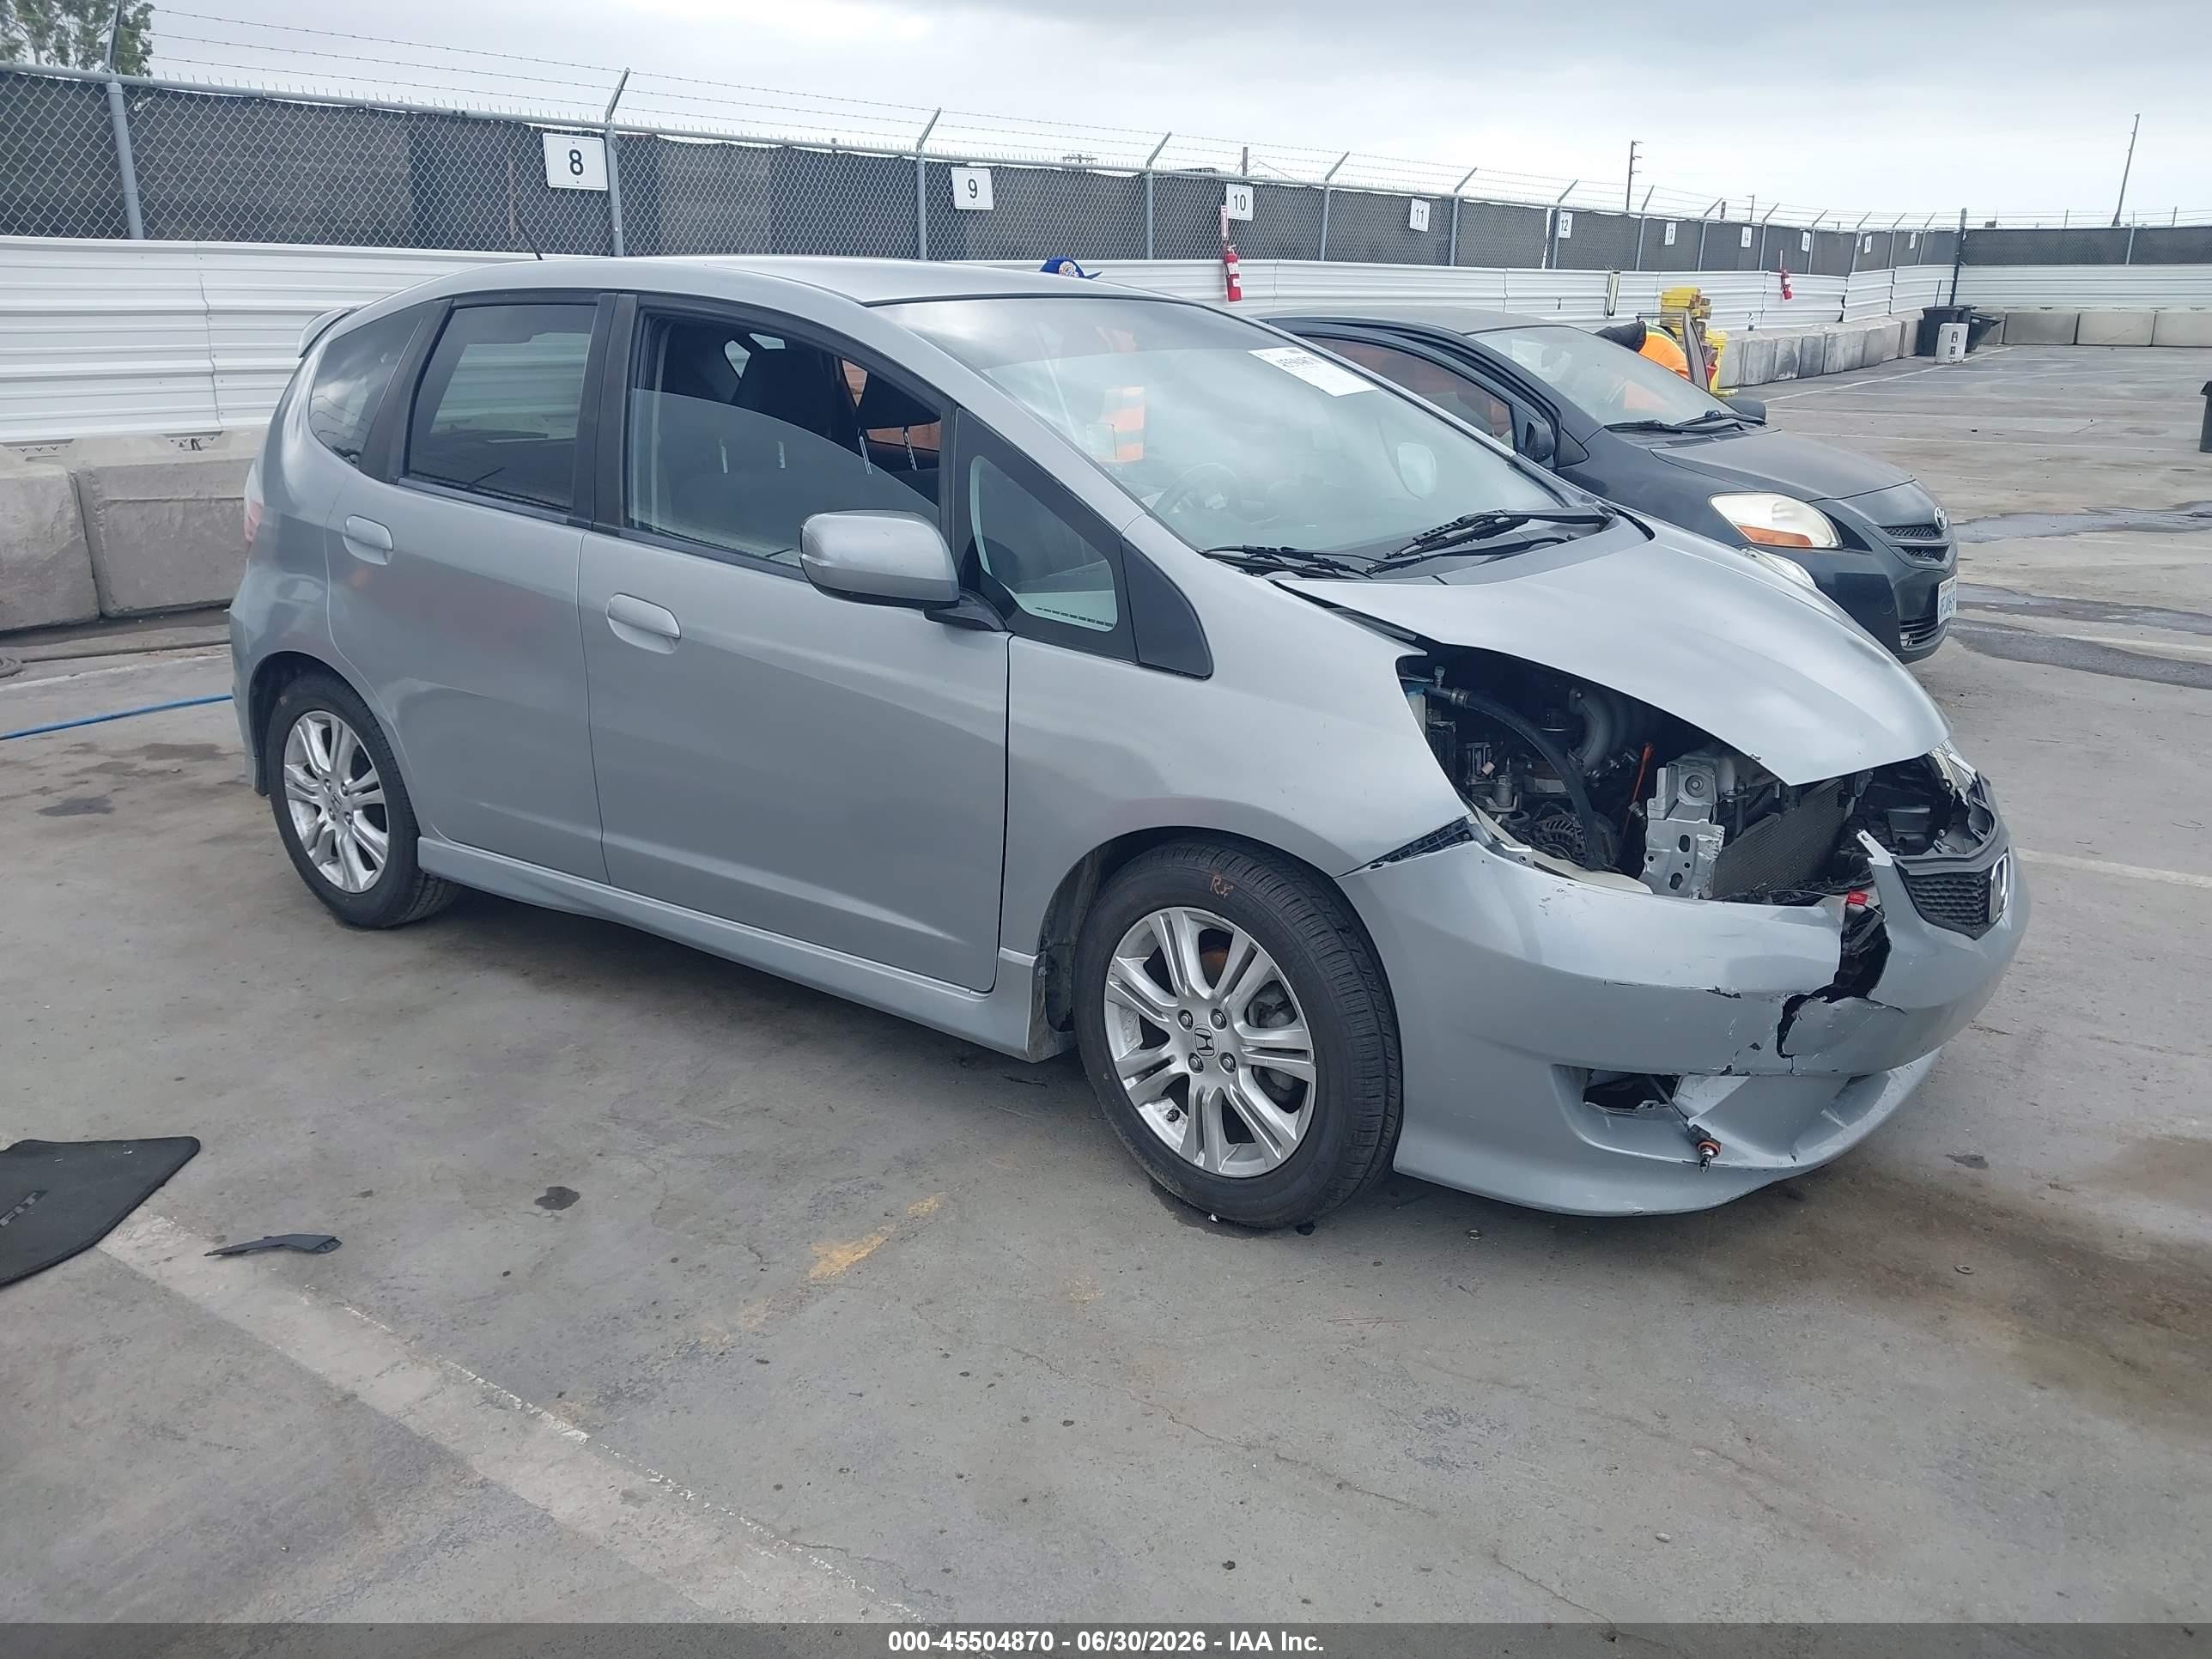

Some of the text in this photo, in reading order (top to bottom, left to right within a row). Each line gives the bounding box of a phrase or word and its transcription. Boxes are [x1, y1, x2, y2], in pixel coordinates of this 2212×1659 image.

[568, 149, 584, 176] 8
[968, 179, 978, 199] 9
[1233, 193, 1247, 211] 10
[1415, 208, 1425, 224] 11
[1560, 219, 1569, 232] 12
